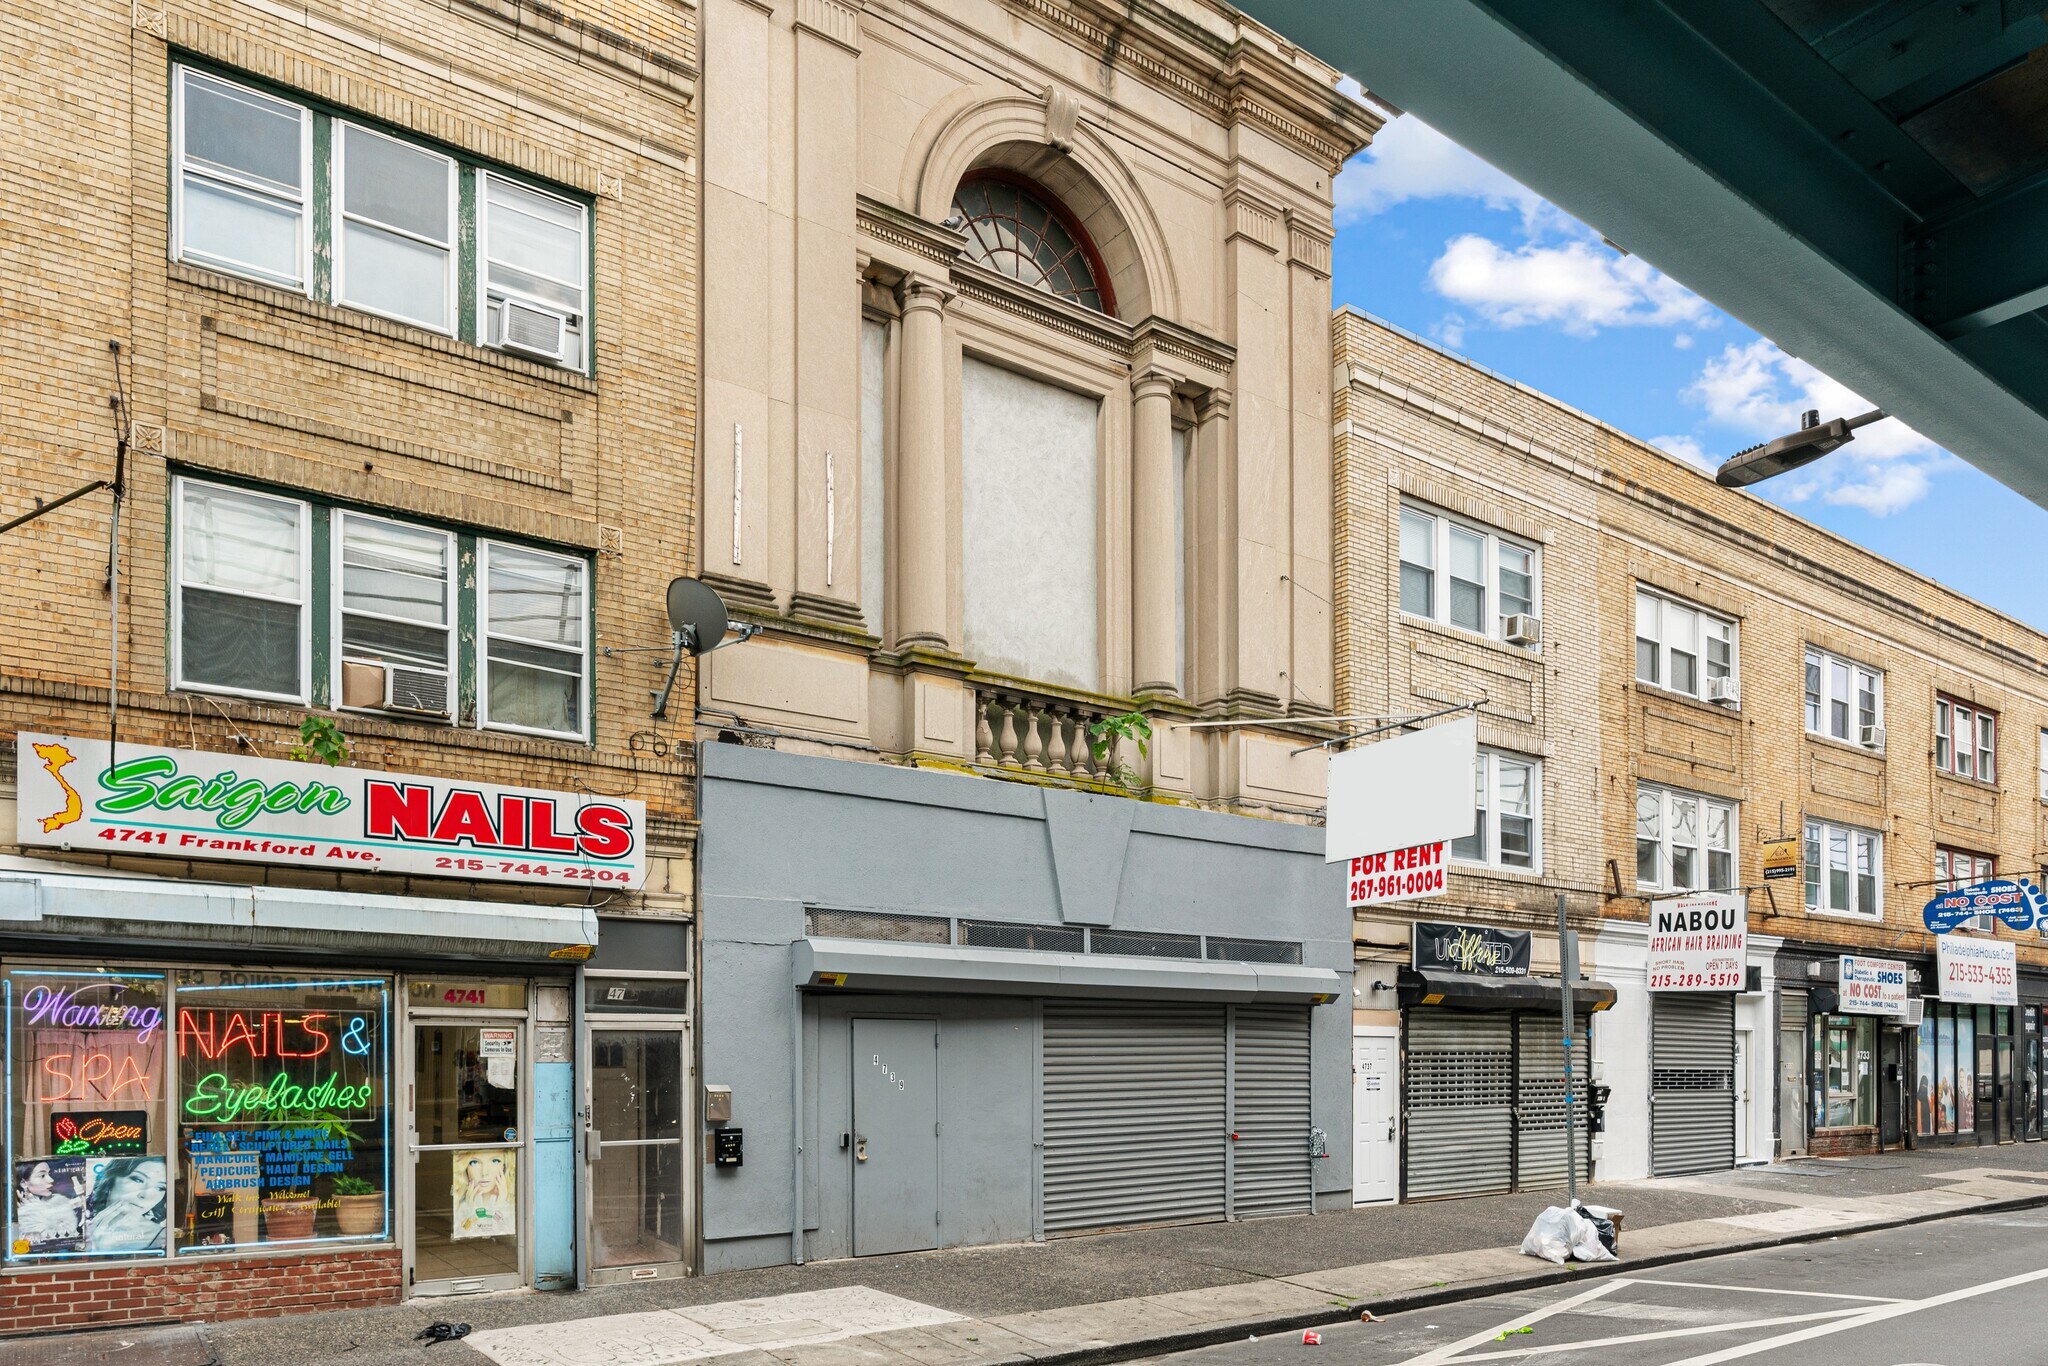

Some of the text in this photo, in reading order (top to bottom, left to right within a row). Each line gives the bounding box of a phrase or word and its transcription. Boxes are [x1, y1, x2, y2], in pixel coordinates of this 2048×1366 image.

[96, 754, 635, 859] Saigon NAILS
[98, 827, 382, 862] 4741 Frankford Ave.
[1351, 841, 1443, 877] FOR RENT
[435, 856, 631, 883] 215-744-2204
[1351, 869, 1442, 901] 267-961-0004
[1991, 885, 2017, 893] SHOES
[1944, 897, 1969, 908] NO
[1974, 893, 2023, 906] COST
[1658, 909, 1735, 933] NABOU
[1651, 934, 1742, 952] AFRICAN HAIR BRAIDING
[1941, 942, 2014, 960] PhiladelphiaHouse.Com
[1706, 961, 1719, 970] OPEN
[1725, 961, 1738, 970] DAYS
[1867, 961, 1887, 969] COMFORT
[1887, 963, 1905, 971] CENTER
[1949, 962, 2012, 985] 215-533-4355
[1651, 973, 1739, 987] 215-289-5519
[1877, 971, 1903, 984] SHOES
[444, 989, 485, 1004] 4741
[1850, 983, 1861, 998] NO
[1864, 984, 1881, 999] COST
[1891, 993, 1905, 1002] patient
[23, 983, 163, 1044] Waxing
[180, 1009, 371, 1058] NAILS &
[1857, 1051, 1870, 1060] 4733
[40, 1054, 151, 1102] SPA
[185, 1071, 372, 1123] Eyelashes
[78, 1119, 142, 1143] Open
[195, 1129, 329, 1141] FULL SET PINK & WHITE
[239, 1141, 311, 1151] SCULPTURED
[315, 1140, 348, 1150] NAILS
[195, 1151, 354, 1164] MANICURE MANICURE GELL
[201, 1163, 344, 1177] PEDICURE HAND DESIGN
[206, 1176, 311, 1189] AIRBRUSH DESIGN
[217, 1194, 241, 1204] Walk
[269, 1190, 310, 1200] Welcome!
[231, 1206, 285, 1215] Certificates
[287, 1199, 341, 1215] Available!
